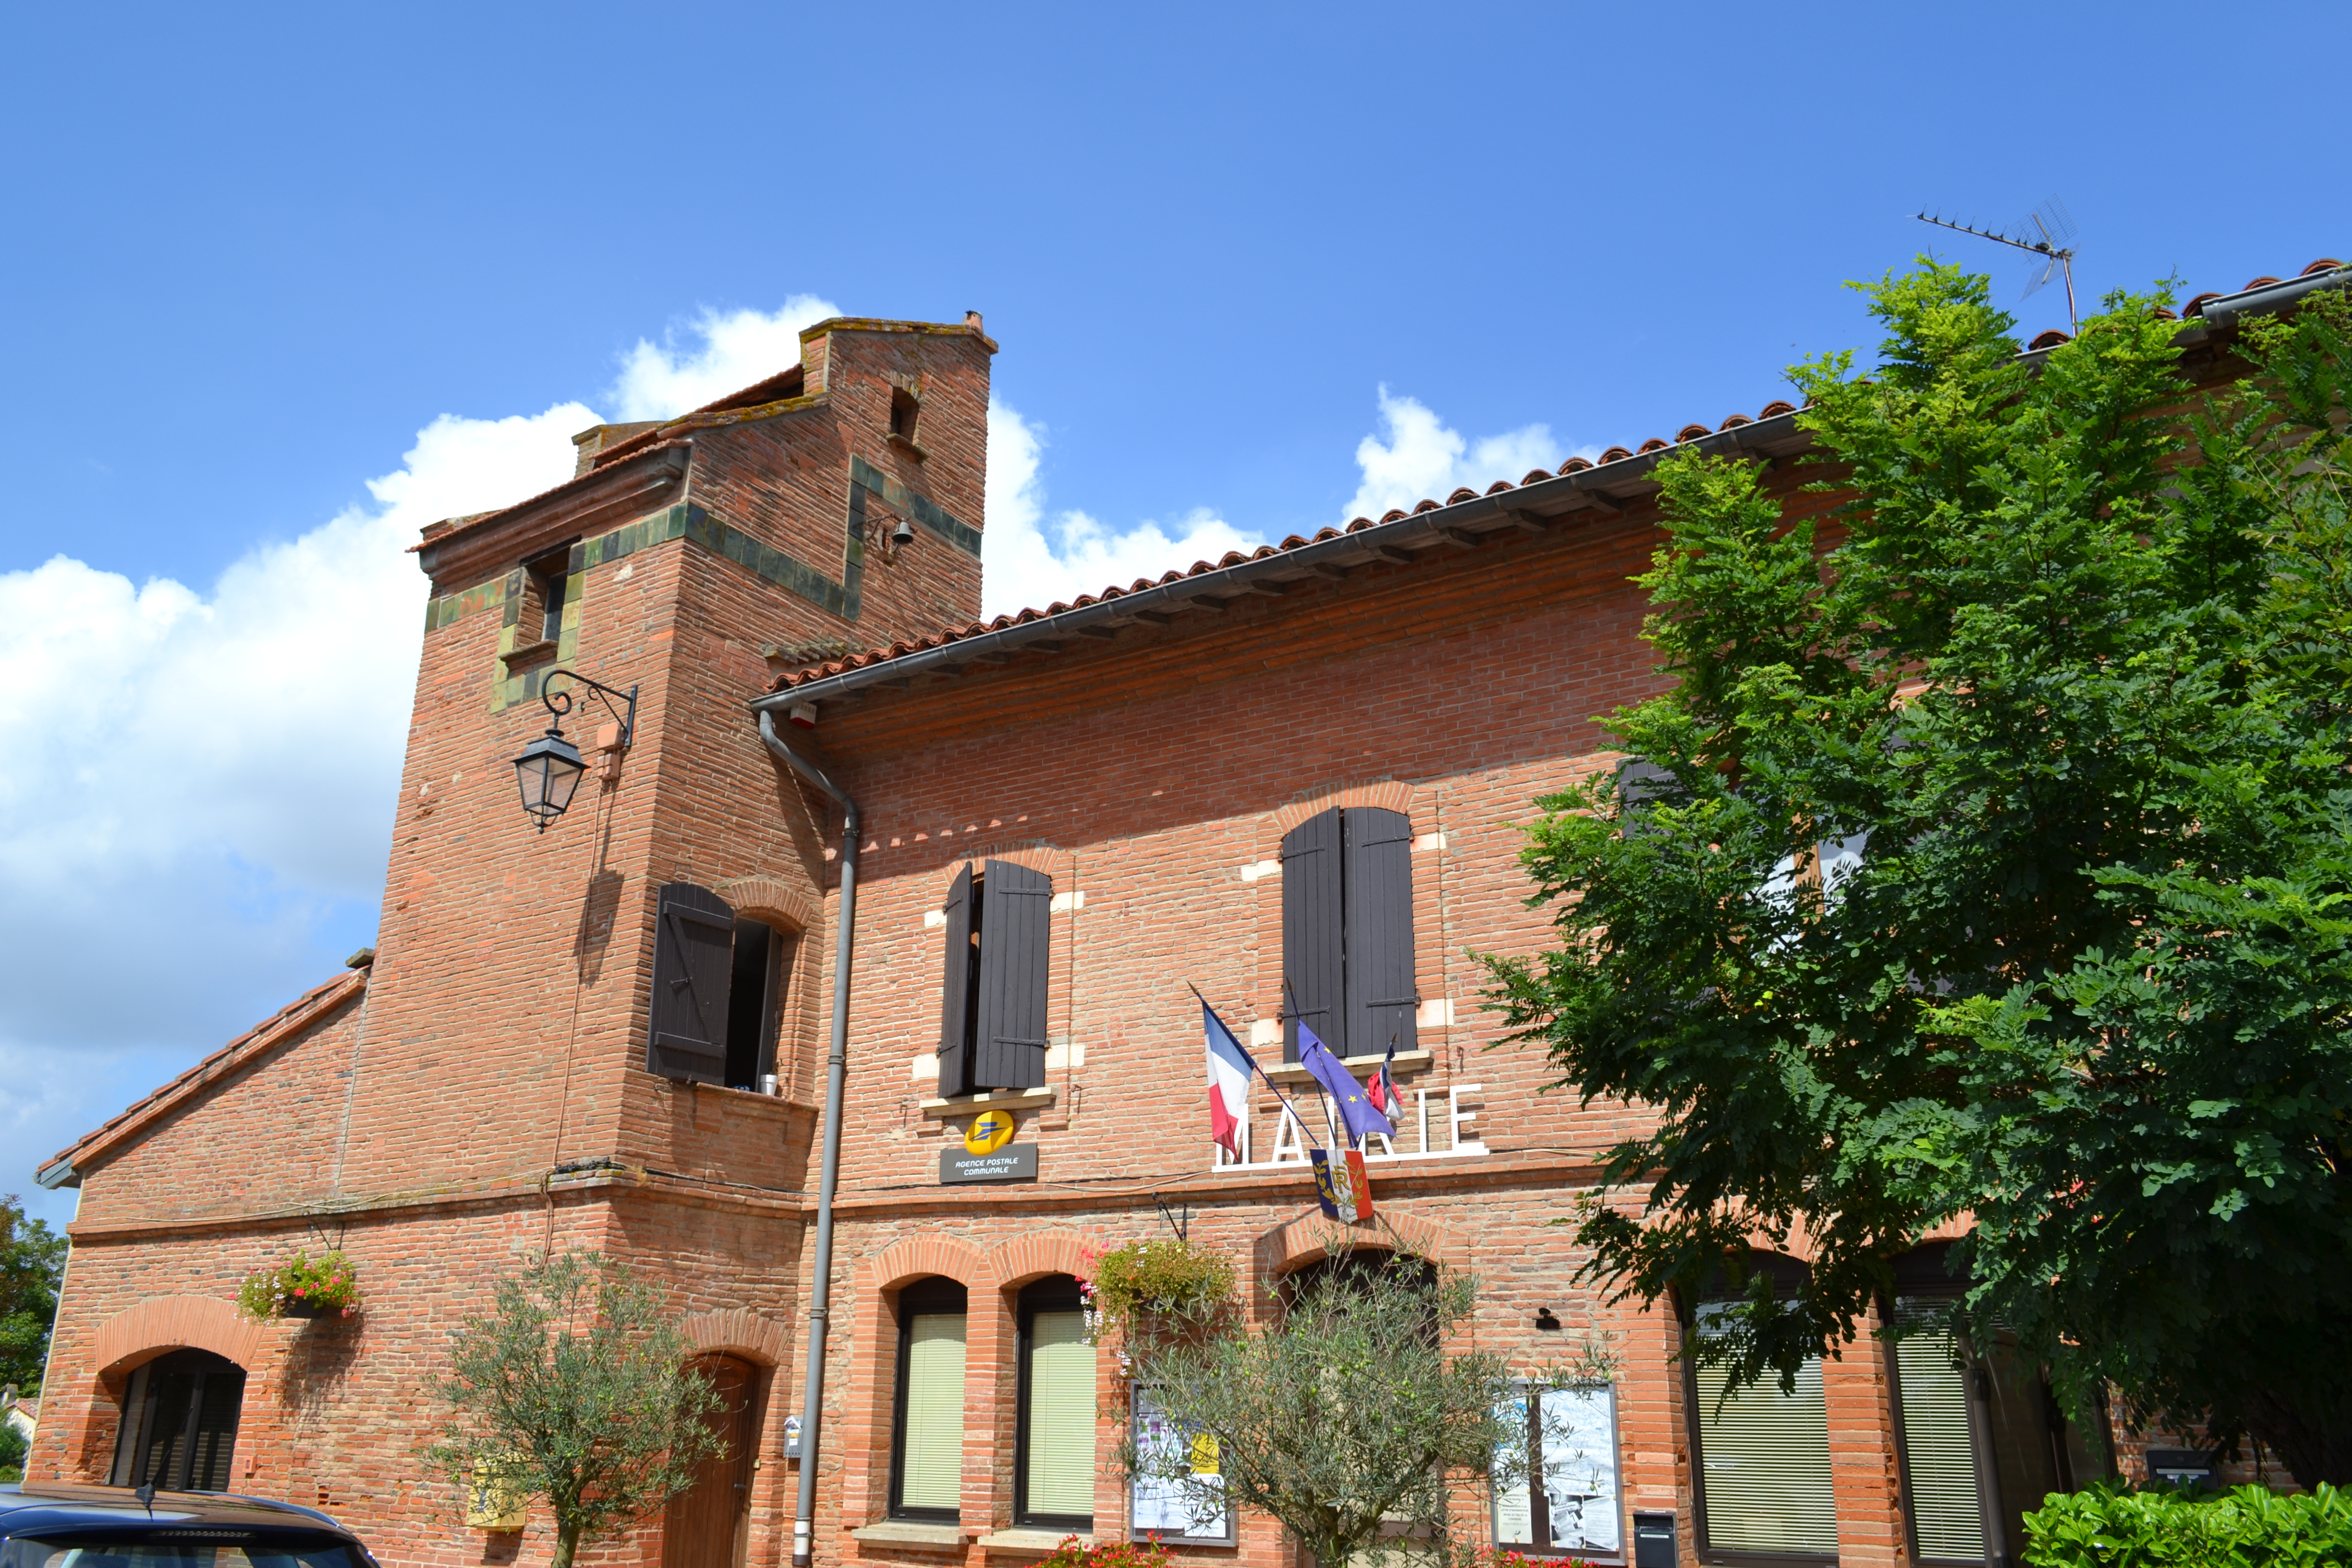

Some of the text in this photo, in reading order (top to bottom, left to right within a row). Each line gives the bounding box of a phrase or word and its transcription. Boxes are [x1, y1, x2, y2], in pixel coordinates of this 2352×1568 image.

[955, 1157, 1019, 1168] AGENCE POSTALE
[964, 1166, 1009, 1176] COMMUNALE
